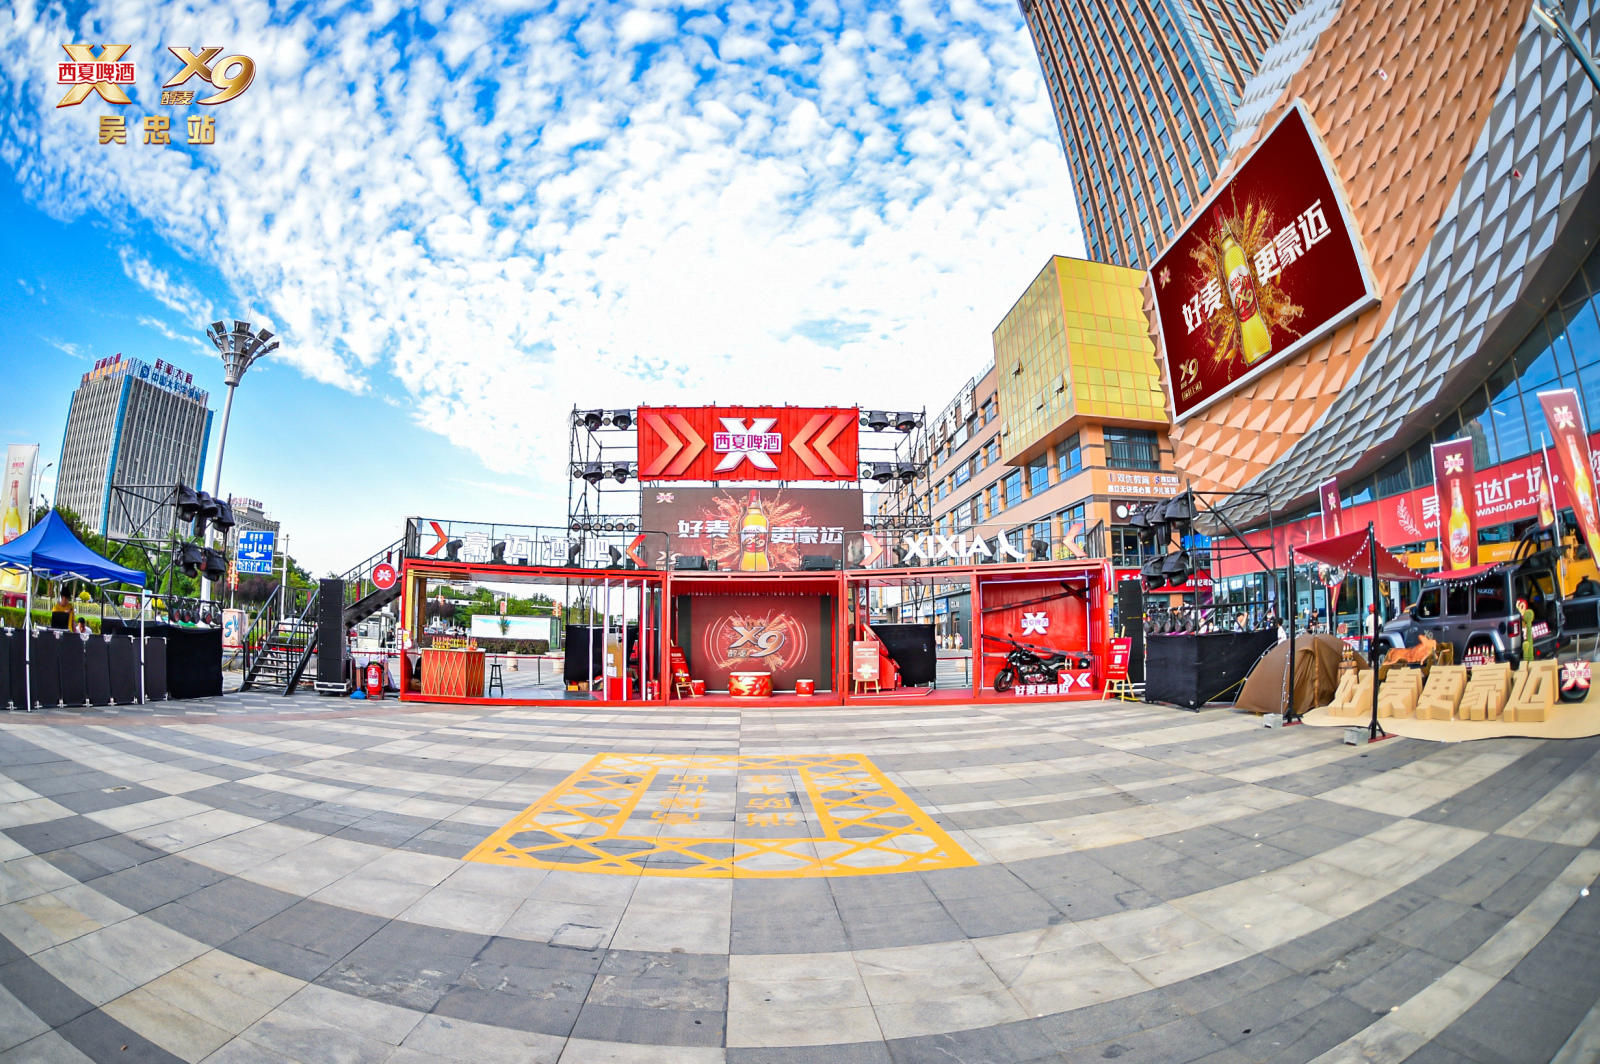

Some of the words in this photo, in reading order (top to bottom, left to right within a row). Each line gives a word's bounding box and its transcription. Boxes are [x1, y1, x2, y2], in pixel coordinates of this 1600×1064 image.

[1182, 277, 1224, 335] 好麦
[1252, 198, 1332, 287] 更豪迈
[714, 433, 781, 452] 西夏啤酒
[1475, 503, 1513, 517] WANDA
[1513, 494, 1542, 509] PLA
[463, 532, 611, 562] 豪迈酒吧
[677, 520, 730, 539] 好麦
[770, 526, 845, 545] 更豪迈
[903, 533, 993, 561] XIXIA
[730, 626, 786, 658] X9
[1328, 658, 1559, 722] 好麦更豪迈
